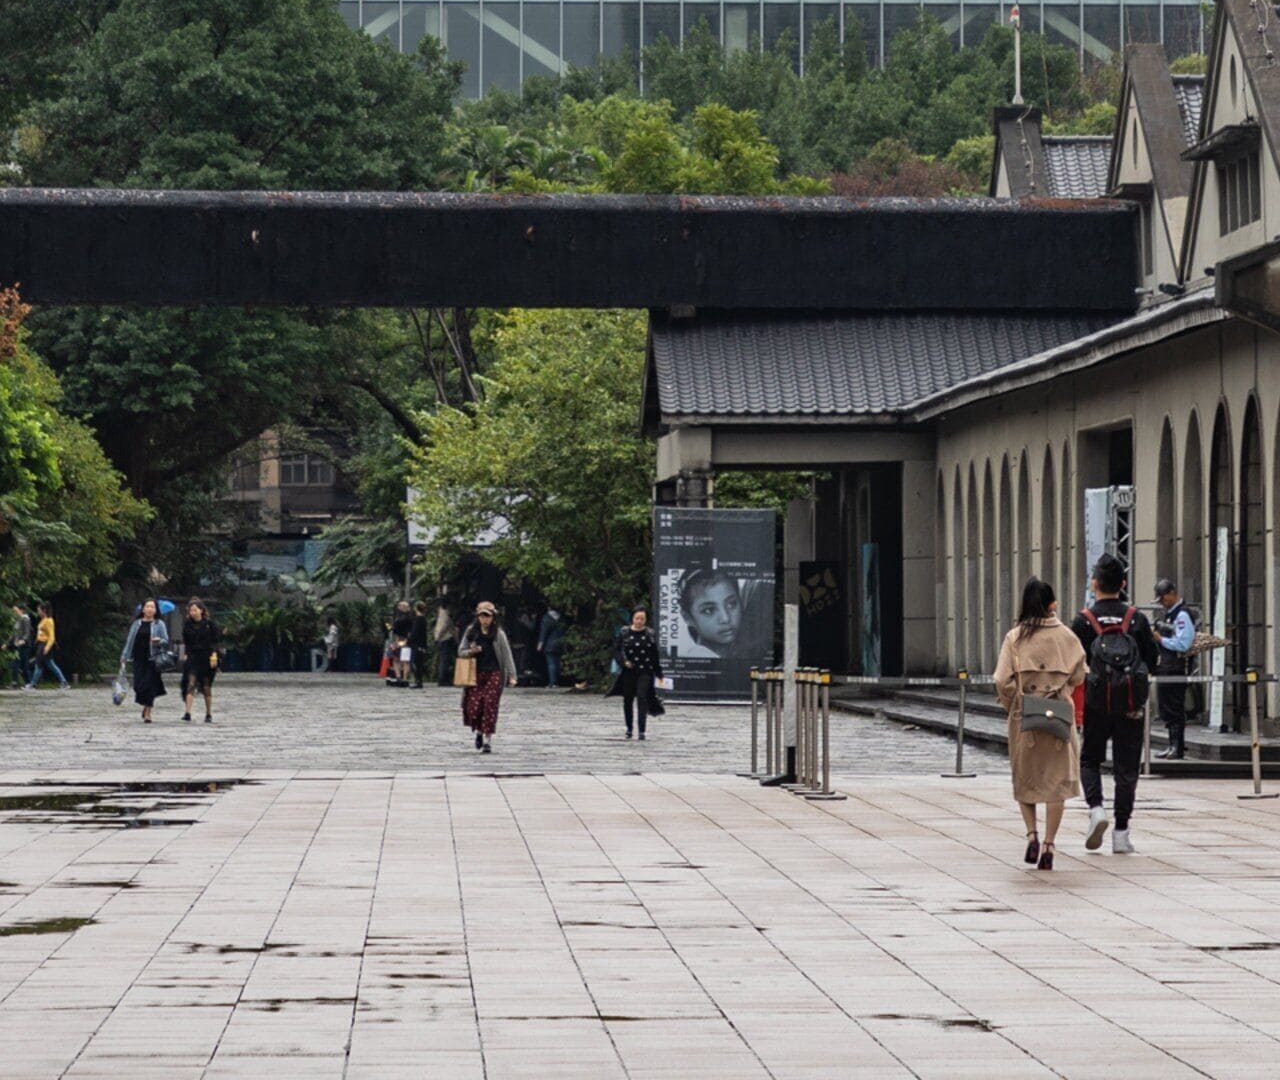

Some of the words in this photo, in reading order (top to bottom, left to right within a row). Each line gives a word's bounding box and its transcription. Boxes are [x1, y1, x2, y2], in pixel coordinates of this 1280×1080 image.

[671, 569, 680, 594] EYES
[660, 584, 669, 611] CARE
[671, 598, 679, 614] ON
[670, 617, 679, 639] YOU
